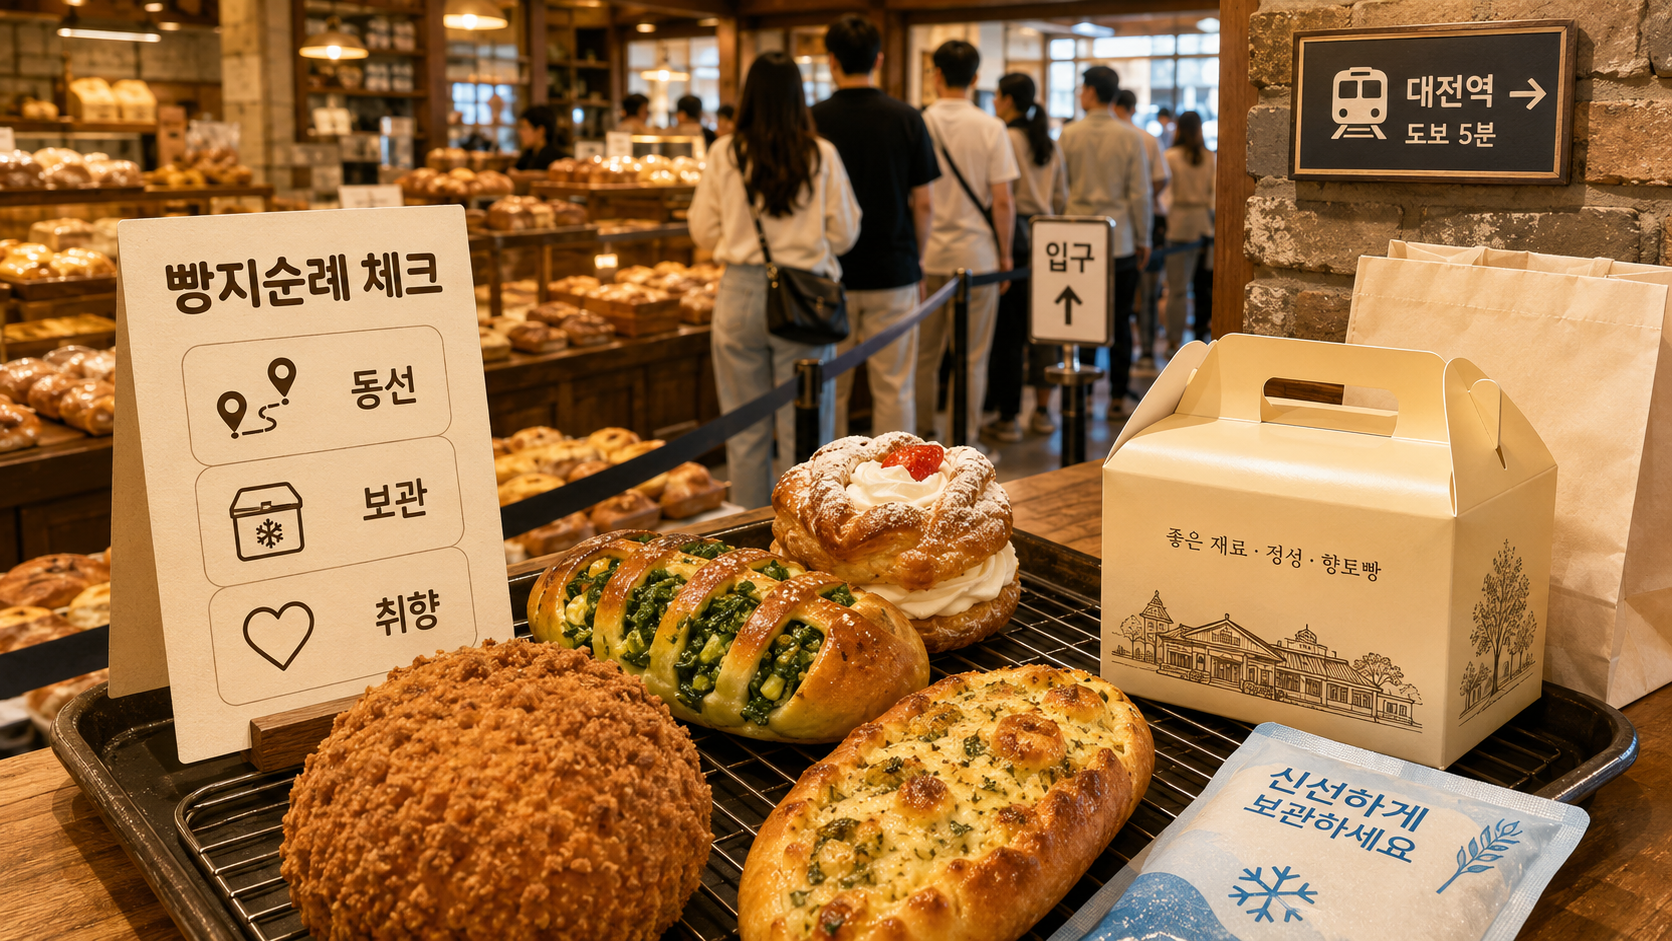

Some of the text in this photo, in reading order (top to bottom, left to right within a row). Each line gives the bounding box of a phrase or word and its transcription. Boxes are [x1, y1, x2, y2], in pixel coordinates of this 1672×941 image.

[1406, 73, 1494, 109] 대전역
[1404, 121, 1497, 148] 도보 5분
[1046, 241, 1095, 274] 입구
[165, 251, 444, 315] 빵지순례 체크
[351, 365, 417, 410] 동선
[362, 477, 428, 521] 보관
[1166, 527, 1204, 551] 좋은
[1210, 535, 1248, 557] 재료
[1266, 544, 1302, 569] 정성
[1321, 553, 1382, 582] 향토빵
[375, 588, 441, 637] 취향
[1268, 767, 1430, 832] 신선하게
[1243, 794, 1416, 863] 보관하세요
